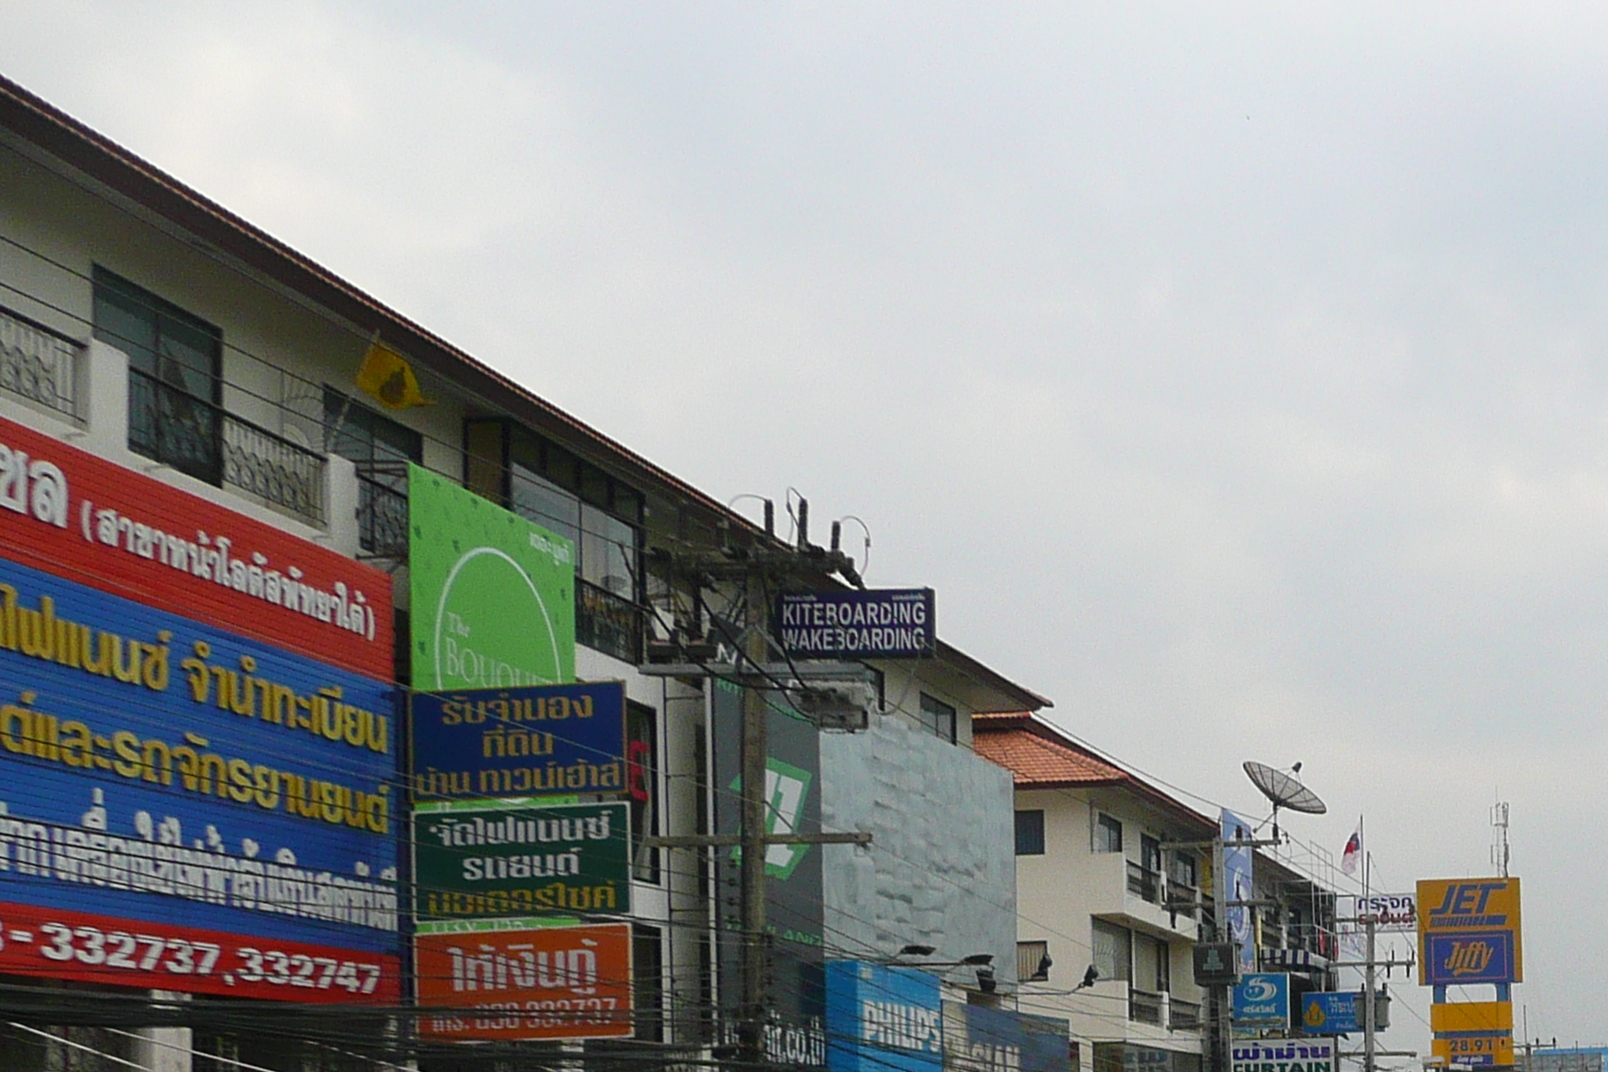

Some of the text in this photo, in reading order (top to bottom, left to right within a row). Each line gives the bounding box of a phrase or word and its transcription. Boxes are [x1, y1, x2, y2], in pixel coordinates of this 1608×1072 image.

[782, 602, 926, 626] KITEBOARDING
[781, 628, 926, 651] WAKEBOARDING
[0, 583, 389, 753] ไฟแนนซ์ จำนำทะเบียน
[442, 693, 594, 725] รับจำนอง
[482, 724, 555, 758] ที่ดิน
[416, 766, 470, 796] บ้าน
[462, 847, 582, 881] รถยนต์
[1429, 883, 1508, 915] JET
[1444, 941, 1494, 976] Jiffy
[863, 999, 942, 1053] PHILIPS
[1233, 1042, 1331, 1061] ผ้าม่าน
[1449, 1038, 1493, 1052] 28.91
